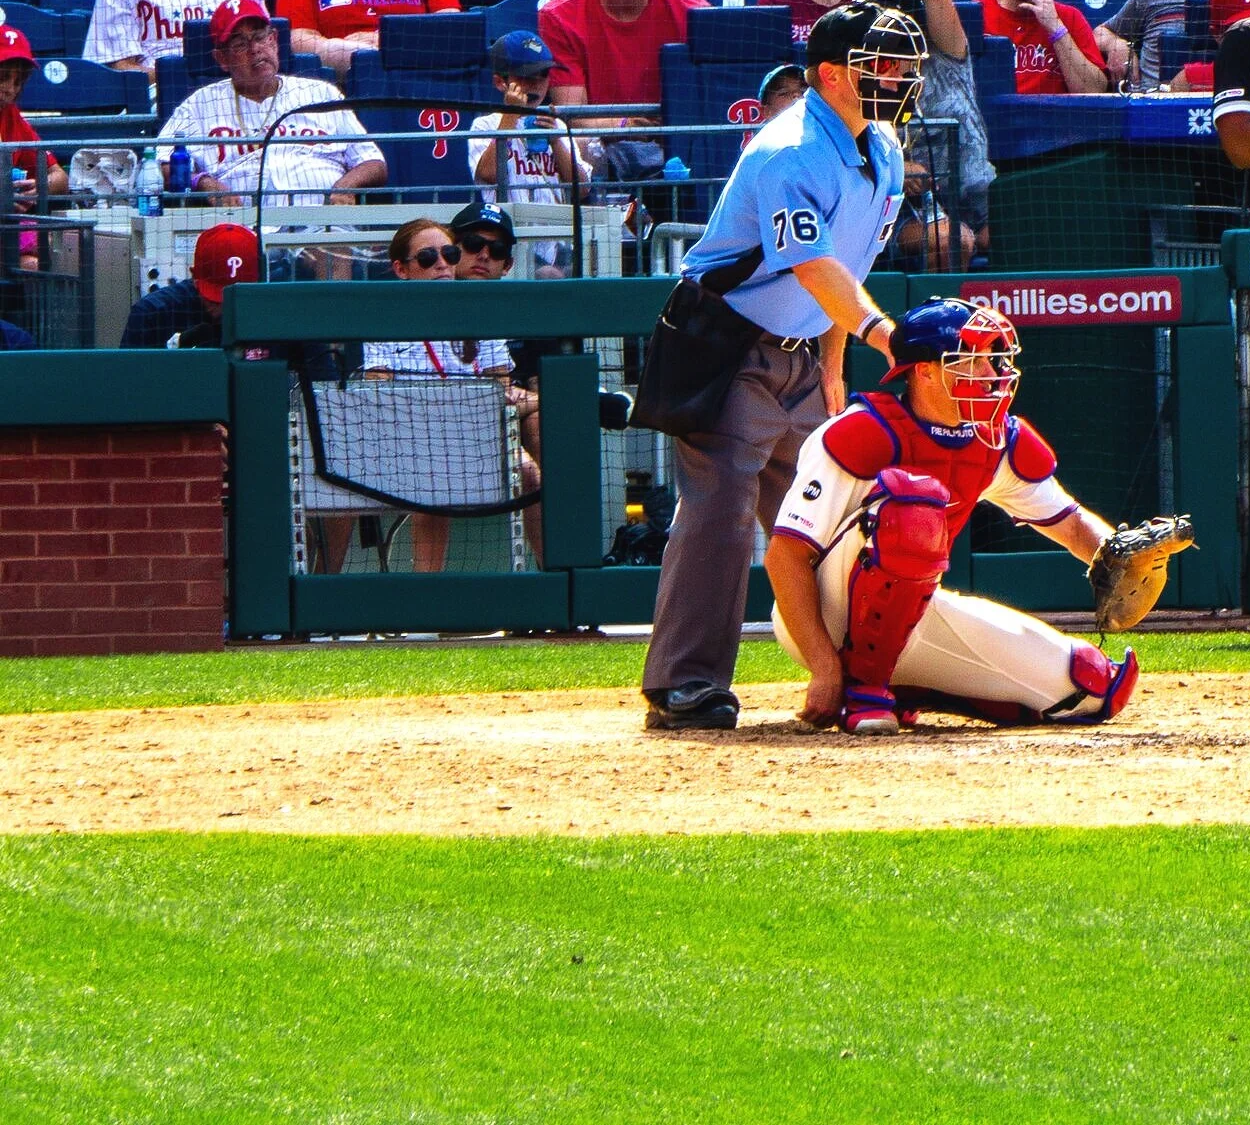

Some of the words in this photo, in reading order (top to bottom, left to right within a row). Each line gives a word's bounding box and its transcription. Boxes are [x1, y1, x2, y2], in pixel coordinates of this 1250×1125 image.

[5, 30, 18, 44] P
[419, 107, 460, 159] P
[773, 207, 819, 252] 76
[227, 256, 244, 278] P
[969, 287, 1174, 320] phillies.com
[930, 426, 975, 440] REALMUTO
